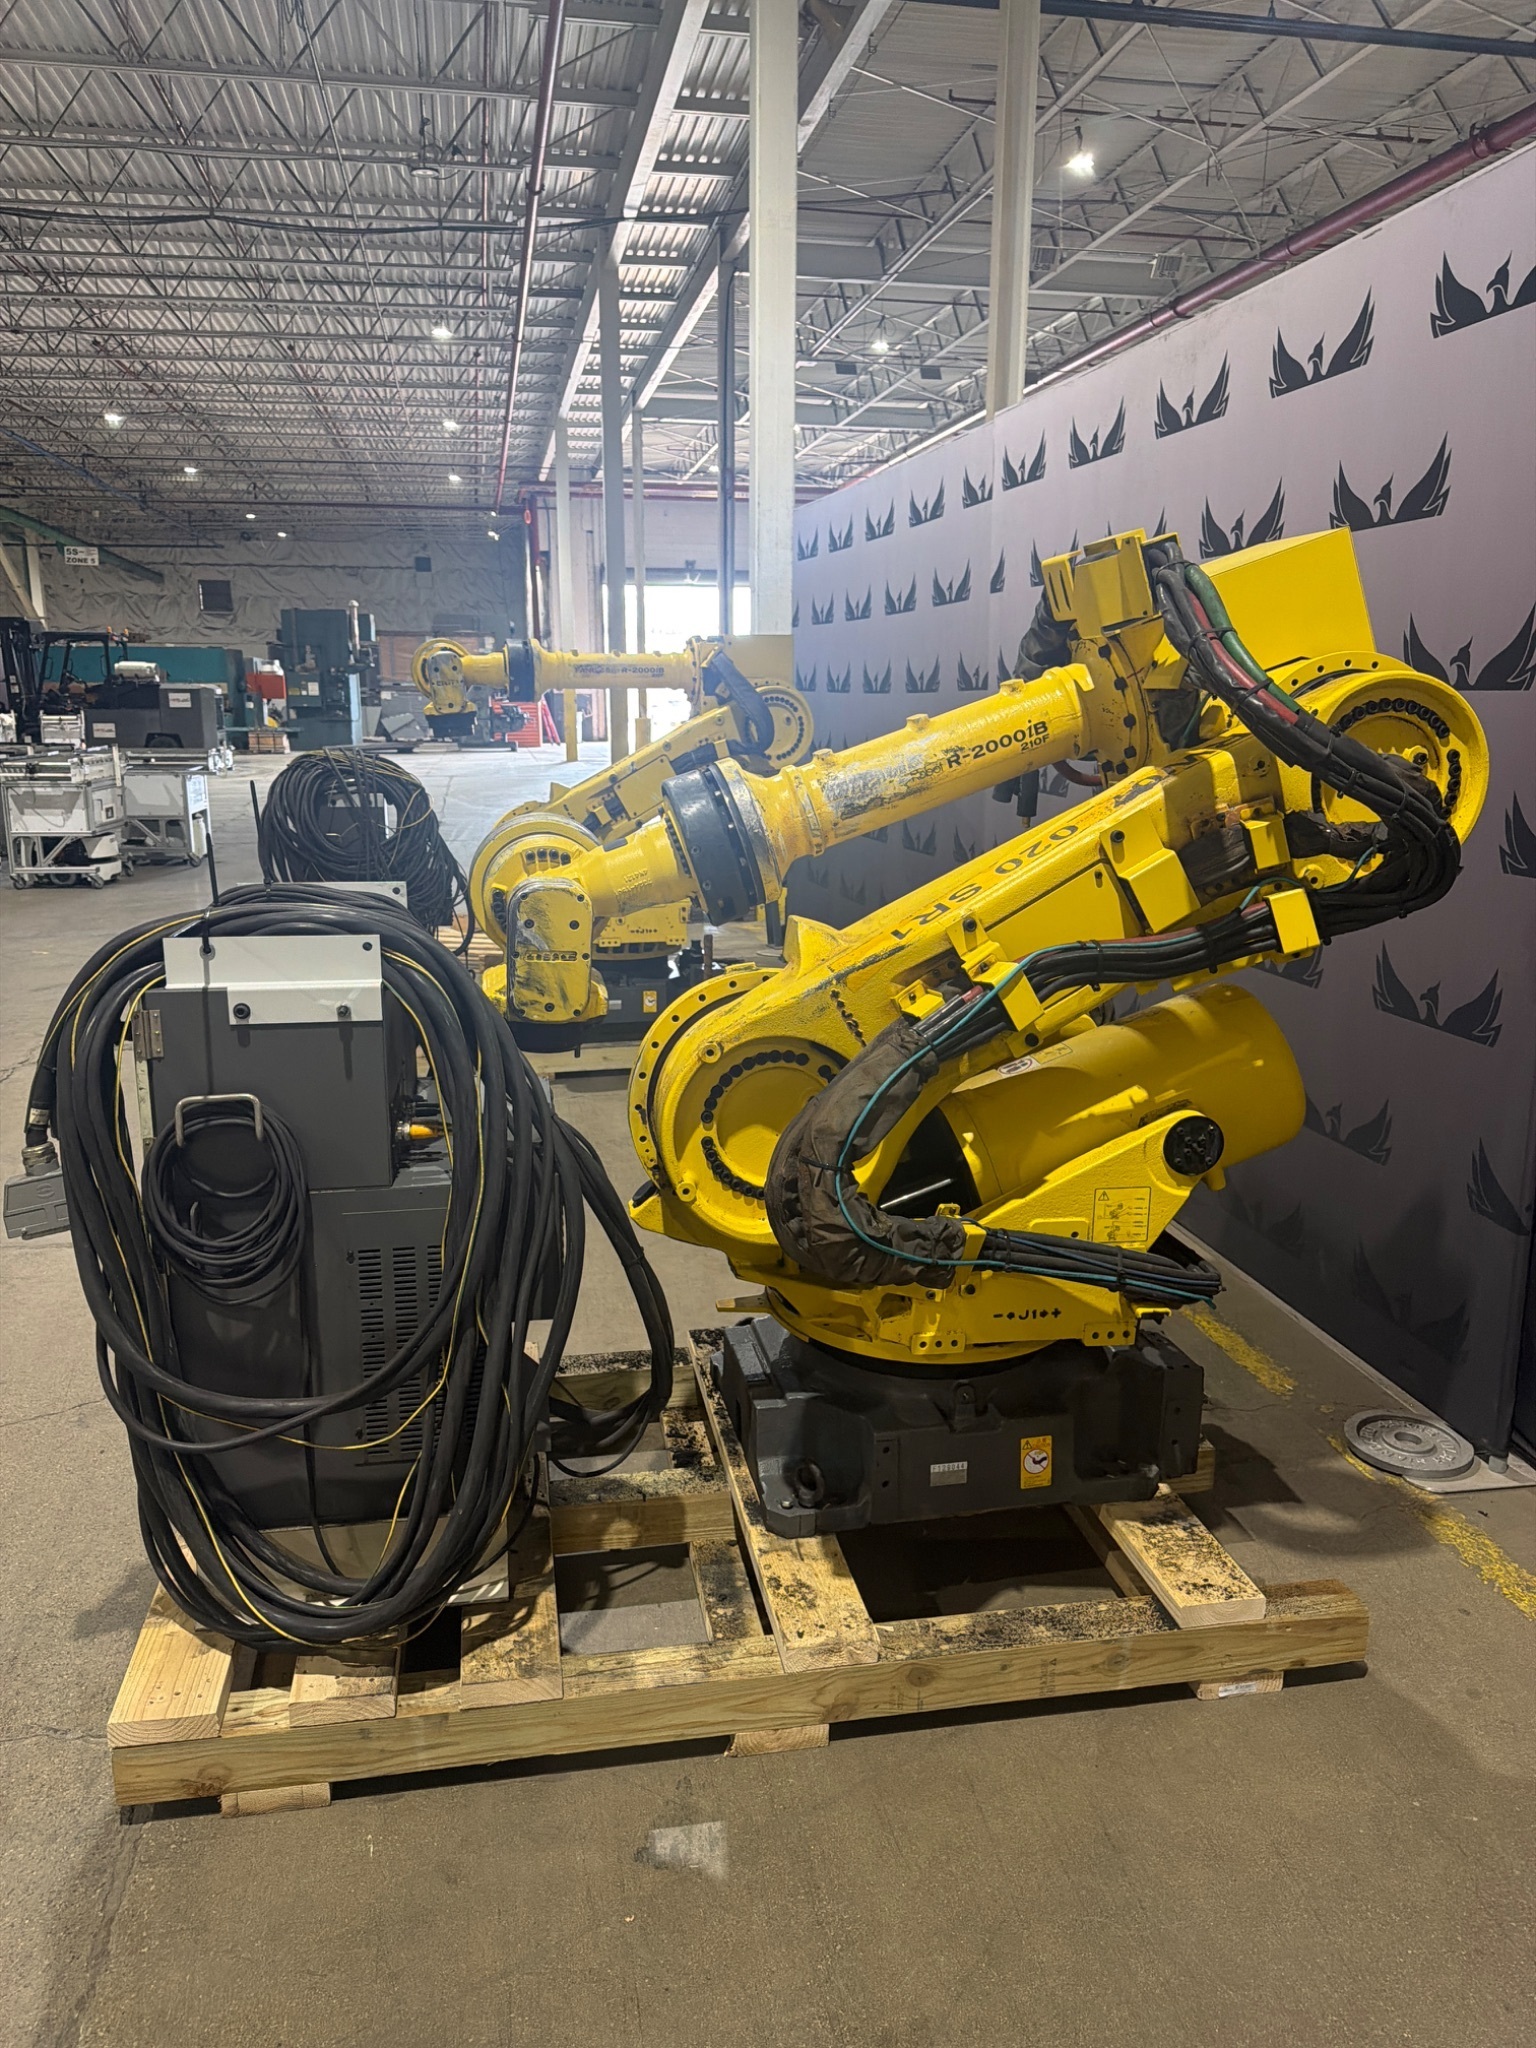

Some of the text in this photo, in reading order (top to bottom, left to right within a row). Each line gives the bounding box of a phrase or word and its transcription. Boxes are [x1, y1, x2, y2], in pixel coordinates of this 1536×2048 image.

[946, 719, 1048, 768] R-2000iB
[1020, 733, 1050, 753] 210F
[891, 825, 1079, 940] 020 SR1
